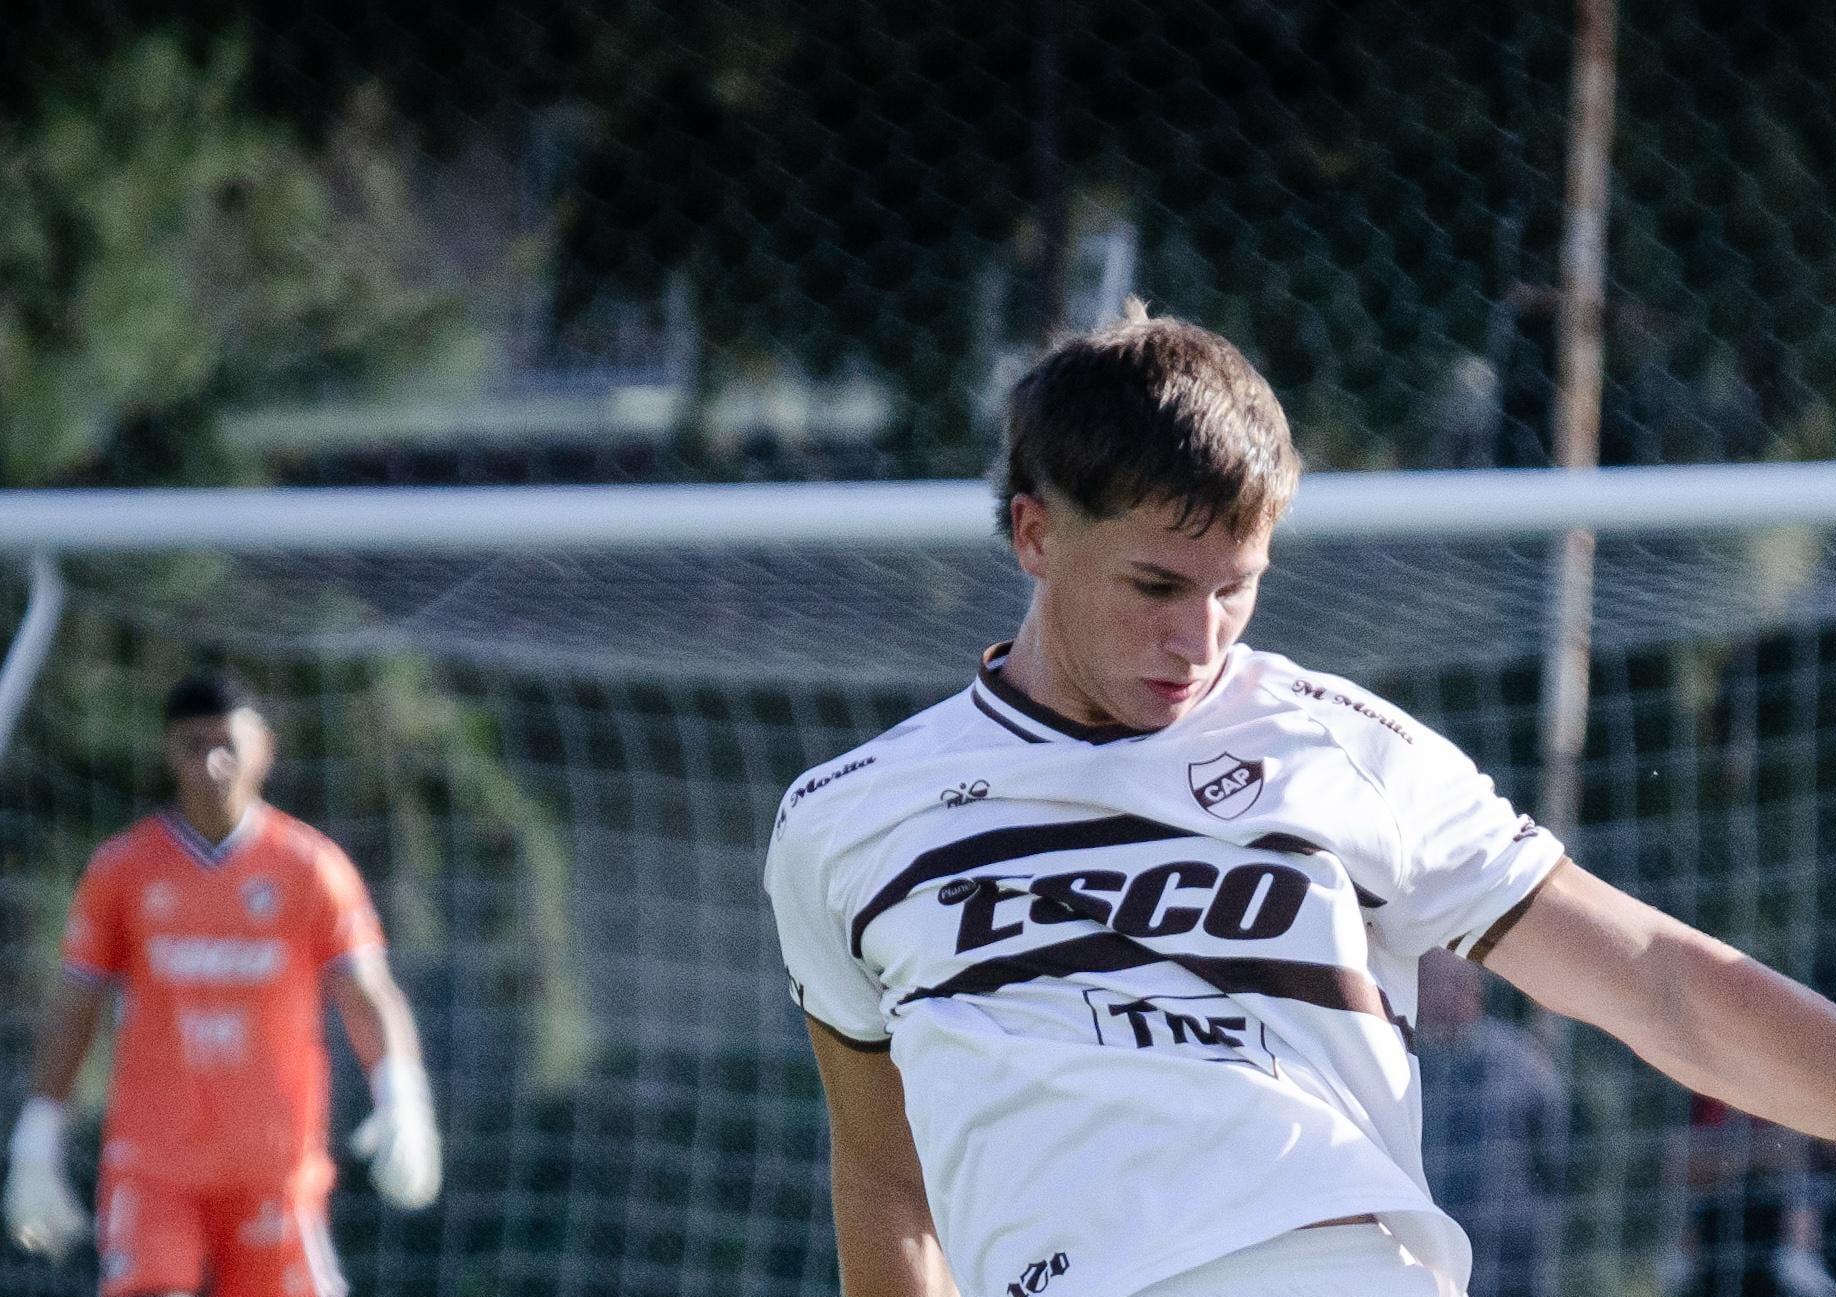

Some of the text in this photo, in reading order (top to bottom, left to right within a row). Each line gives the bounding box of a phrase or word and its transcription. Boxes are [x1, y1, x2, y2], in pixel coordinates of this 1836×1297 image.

[1332, 694, 1414, 745] Morita
[1204, 767, 1250, 801] CAP
[954, 860, 1312, 956] ESCO
